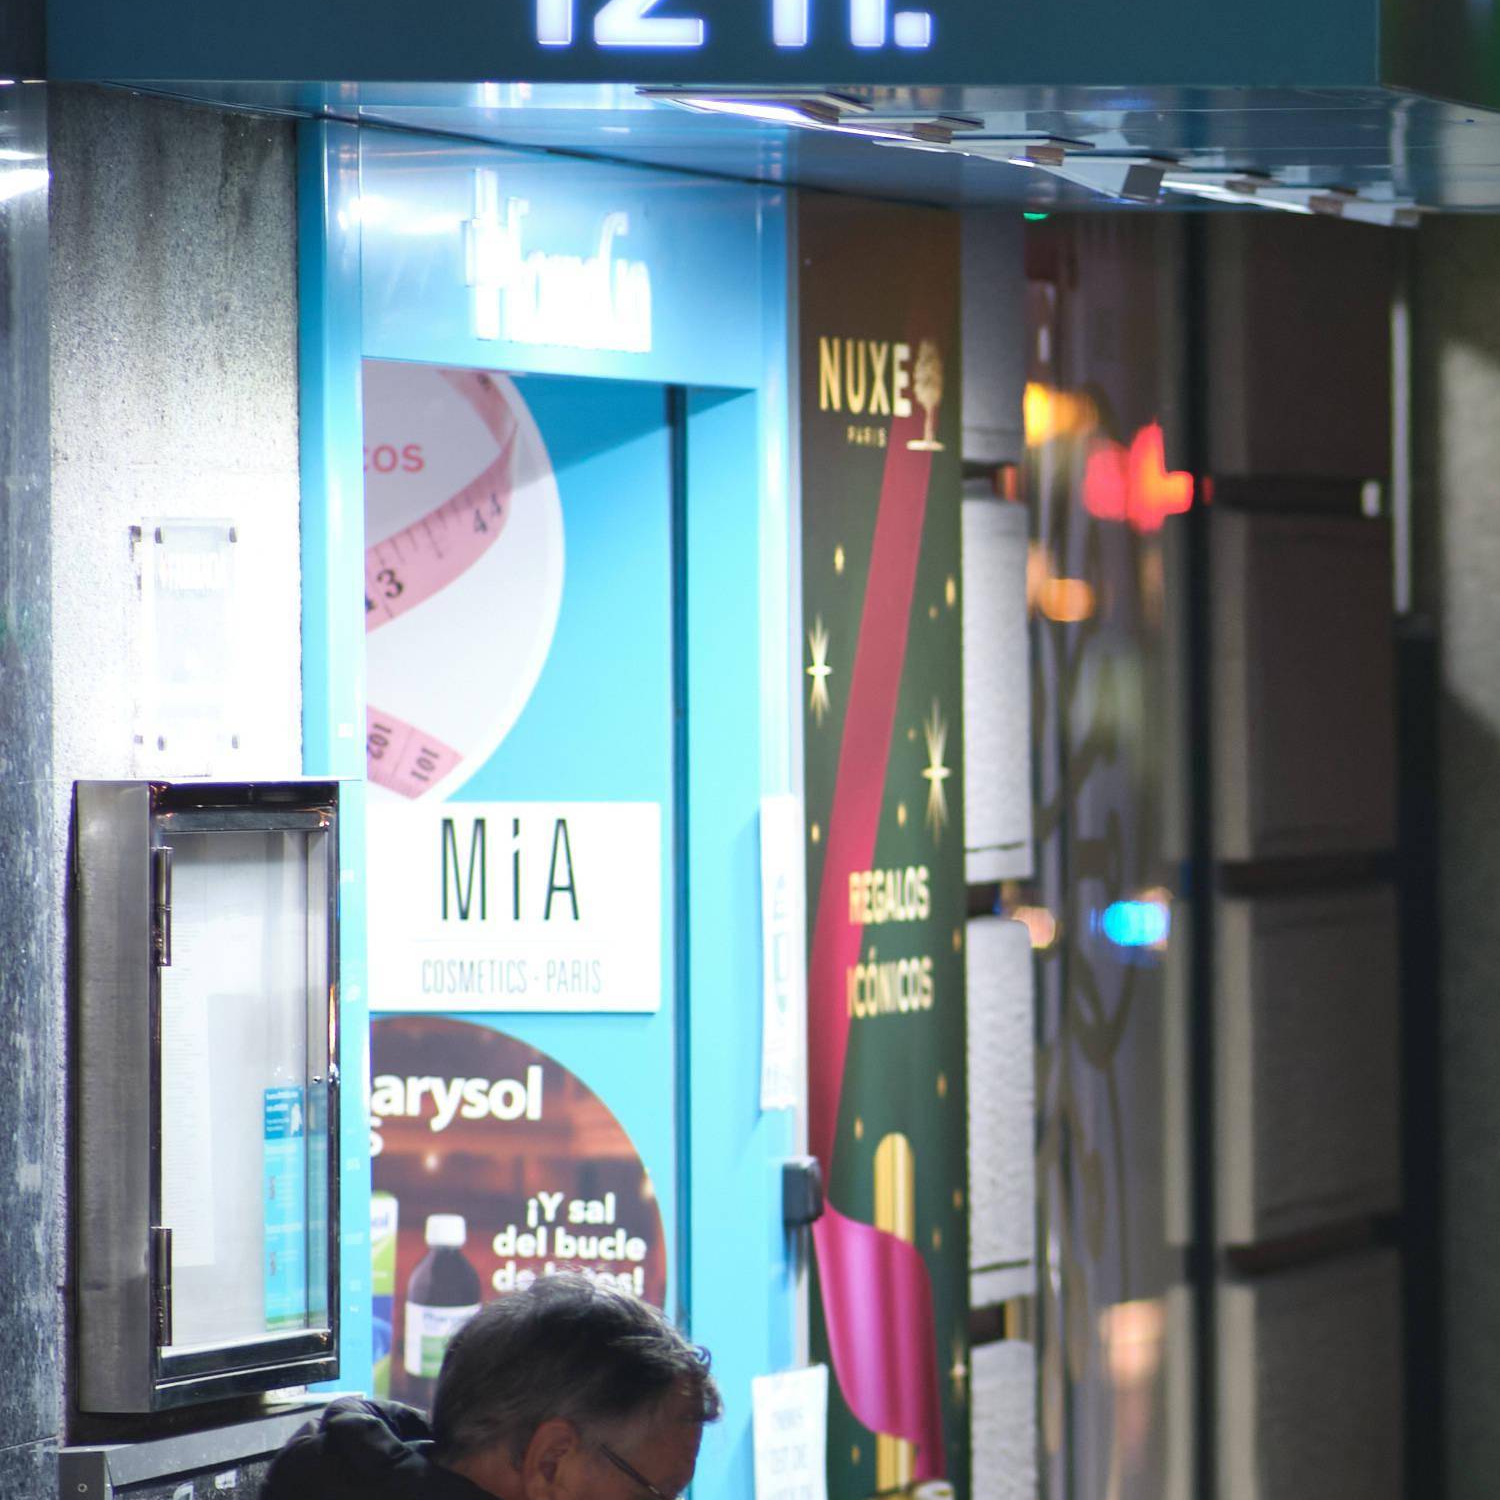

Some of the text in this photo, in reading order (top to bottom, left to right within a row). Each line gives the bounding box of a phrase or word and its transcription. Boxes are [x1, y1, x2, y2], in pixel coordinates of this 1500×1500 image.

[819, 336, 912, 417] NUXE
[364, 444, 425, 473] os
[849, 866, 930, 925] REGALOS
[421, 958, 603, 994] COSMETICS PARIS
[527, 1191, 616, 1229] ¡Y sal
[493, 1224, 648, 1262] del bucle
[492, 1260, 537, 1292] de
